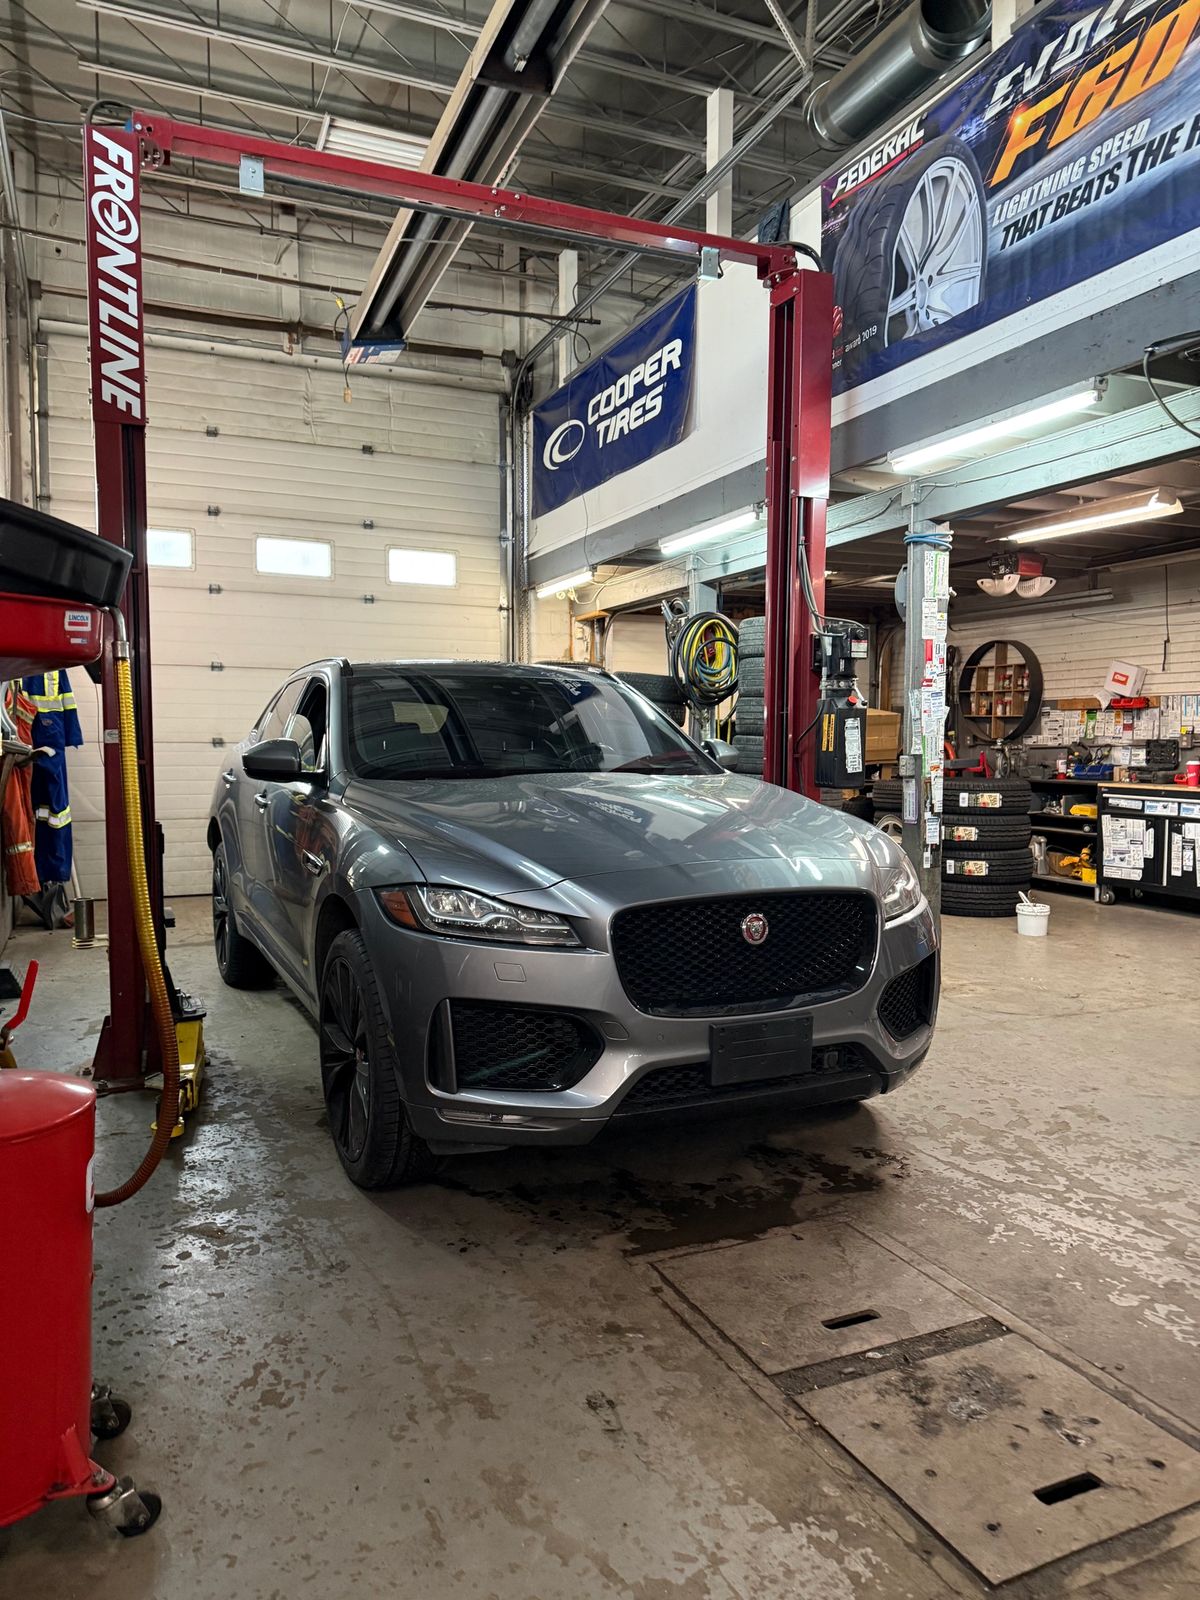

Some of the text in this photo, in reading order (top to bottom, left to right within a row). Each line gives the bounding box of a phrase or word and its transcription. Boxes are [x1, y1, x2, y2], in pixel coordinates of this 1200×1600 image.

[832, 116, 925, 200] FEDERAL
[992, 118, 1151, 228] LIGHTNING SPEED
[1000, 201, 1053, 251] THAT
[1051, 161, 1123, 223] BEATS
[1125, 120, 1186, 184] THE
[91, 130, 141, 420] FRONTLINE
[587, 338, 682, 426] COOPER
[845, 325, 878, 352] award 2019
[596, 384, 663, 448] TIRES
